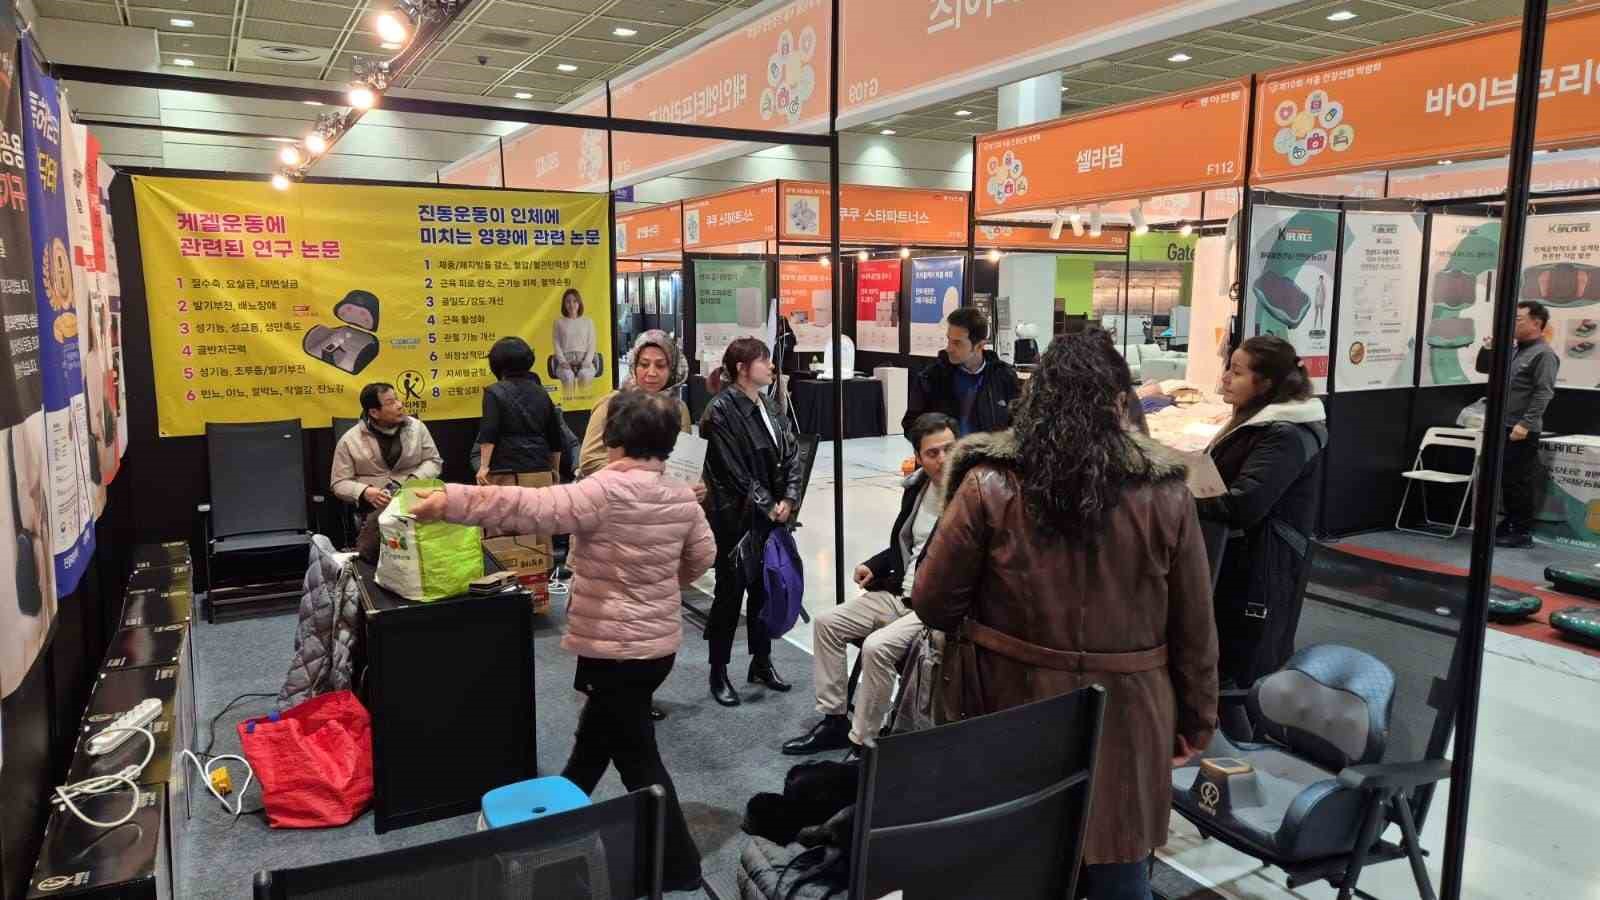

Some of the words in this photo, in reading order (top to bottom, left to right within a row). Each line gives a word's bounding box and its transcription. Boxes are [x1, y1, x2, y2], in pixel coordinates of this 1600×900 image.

[1425, 57, 1600, 117] 바이브코리
[1076, 143, 1124, 173] 셀라덤
[1207, 160, 1234, 176] F112
[418, 205, 504, 224] 진동운동이
[511, 207, 560, 225] 인체에
[864, 207, 930, 224] 스타파트너스
[176, 212, 287, 234] 케겔운동에
[420, 227, 472, 245] 미치는
[478, 228, 528, 245] 영향에
[534, 230, 565, 246] 관련
[570, 230, 600, 246] 논문
[180, 238, 245, 257] 관련된
[252, 240, 293, 258] 연구
[300, 240, 341, 259] 논문
[424, 259, 432, 270] 1
[176, 278, 184, 288] 1
[425, 278, 433, 289] 2
[177, 301, 188, 311] 2
[426, 296, 434, 307] 3
[427, 314, 436, 325] 4
[180, 323, 190, 334] 3
[428, 333, 437, 344] 5
[181, 345, 192, 356] 4
[429, 351, 438, 362] 6
[183, 368, 194, 379] 5
[431, 368, 439, 379] 7
[186, 390, 196, 401] 6
[432, 386, 440, 397] 8
